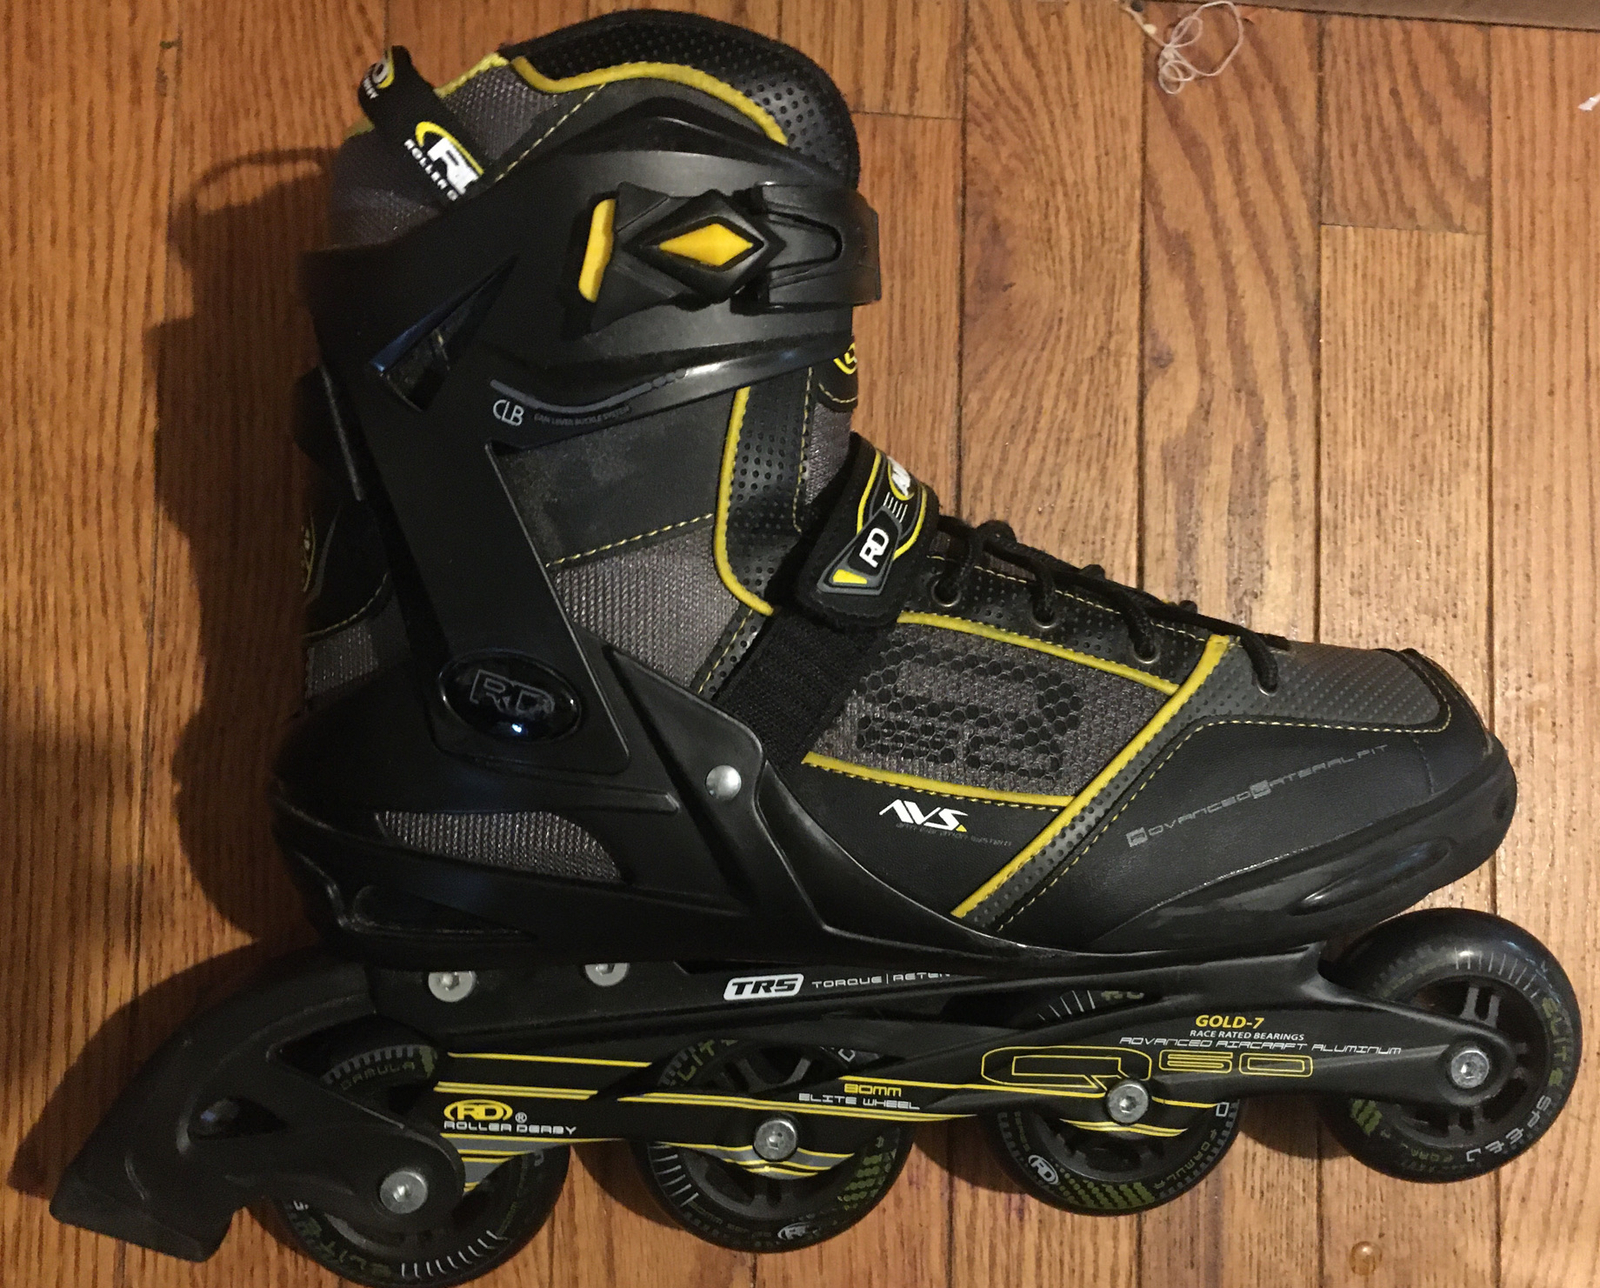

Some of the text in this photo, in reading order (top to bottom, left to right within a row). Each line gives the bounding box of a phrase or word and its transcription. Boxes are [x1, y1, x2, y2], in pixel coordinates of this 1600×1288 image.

[859, 527, 890, 569] RD
[729, 977, 801, 997] TRS
[811, 975, 882, 989] TORQUE
[1194, 1014, 1265, 1030] GOLD-7
[1189, 1029, 1305, 1042] RACE RATED BEARINGS
[1119, 1036, 1402, 1056] ADVANCED AIRCRAFT ALUMINUM
[338, 1060, 417, 1091] ORMULA
[798, 1092, 921, 1111] ELITE WHEEL
[452, 1102, 508, 1121] RD
[443, 1120, 577, 1136] ROLLER DERBY
[1153, 1128, 1218, 1191] FORMULA
